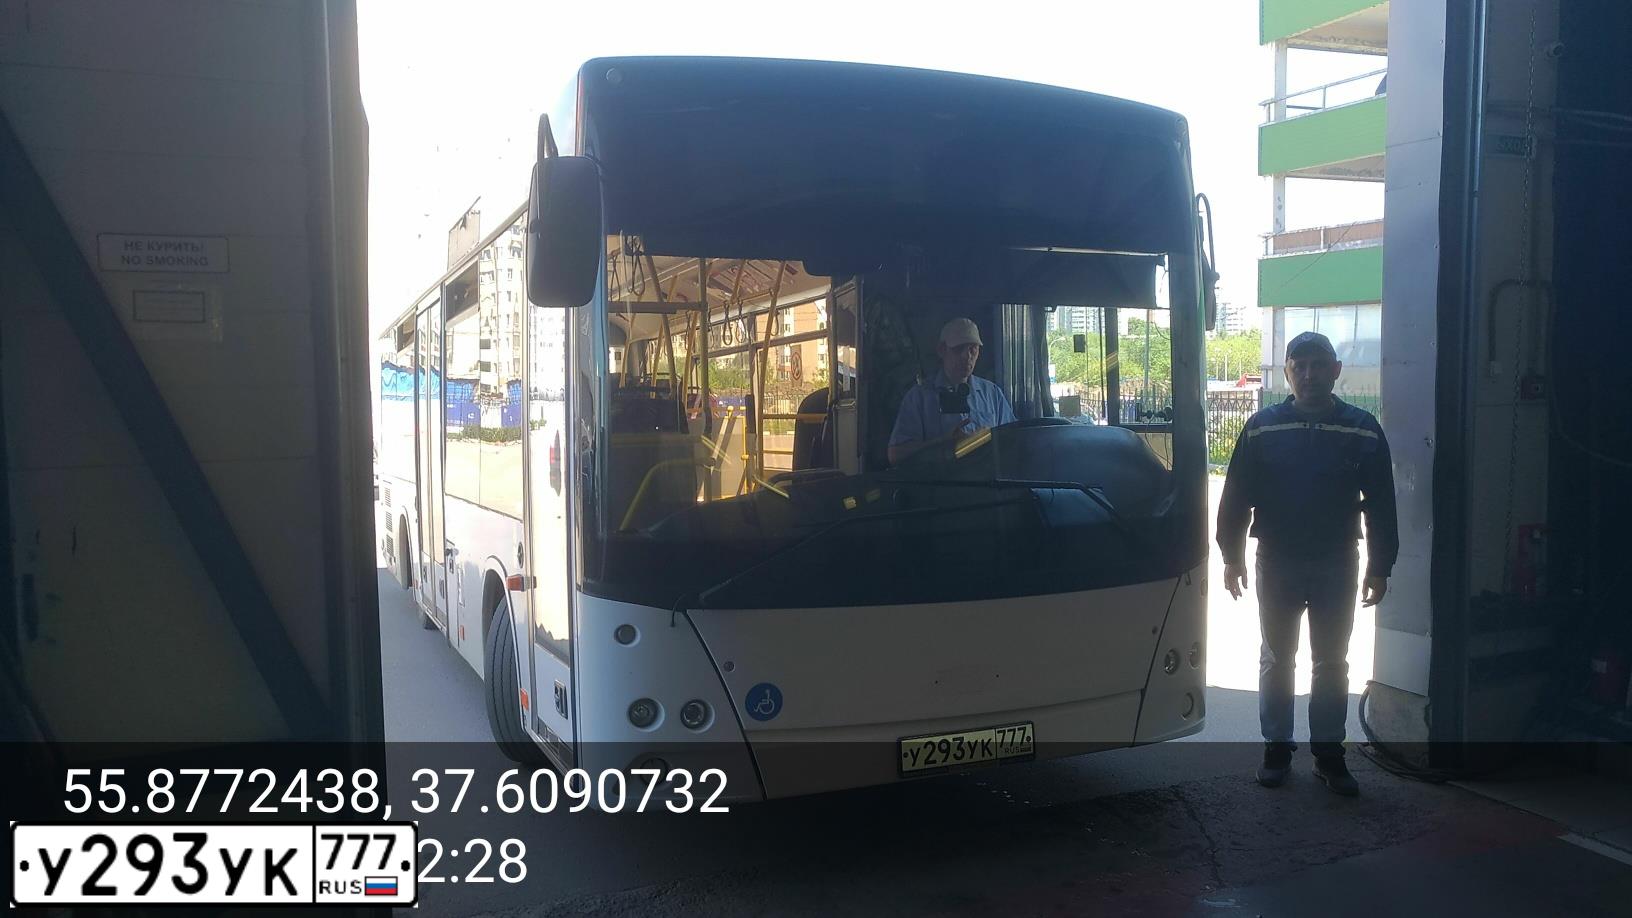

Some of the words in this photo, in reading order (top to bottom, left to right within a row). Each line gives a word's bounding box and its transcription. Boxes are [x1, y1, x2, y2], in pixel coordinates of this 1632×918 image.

[124, 240, 143, 251] НЕ
[121, 255, 141, 265] NO
[146, 255, 208, 266] SMOKING
[997, 726, 1027, 748] 777
[1004, 746, 1020, 754] RUS
